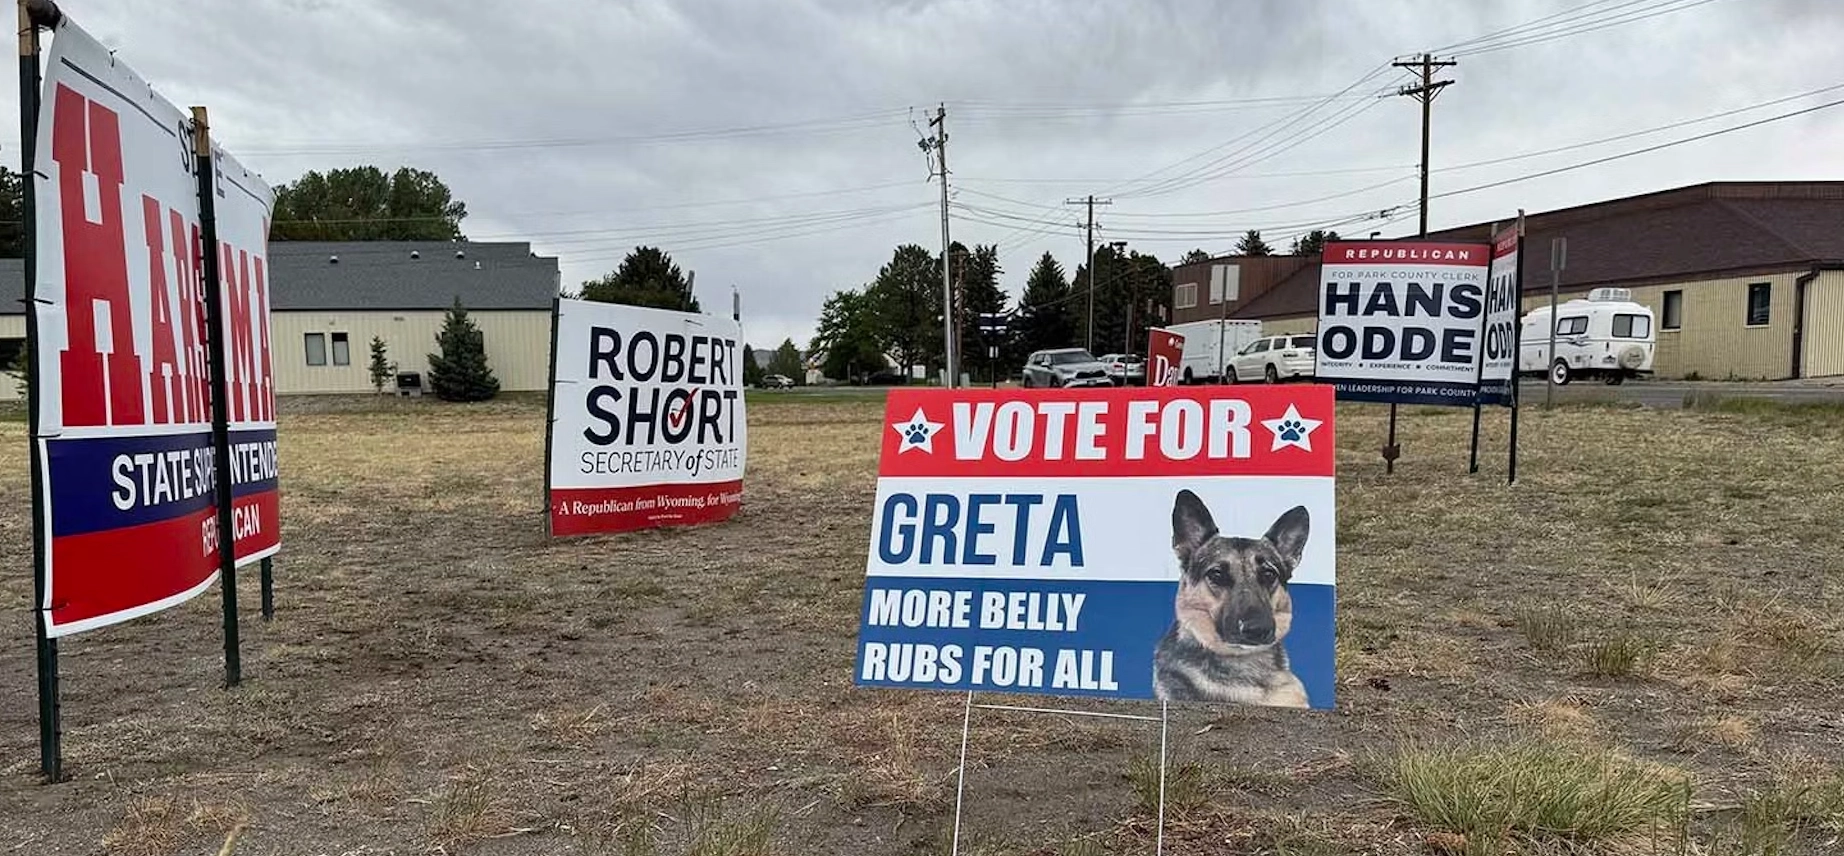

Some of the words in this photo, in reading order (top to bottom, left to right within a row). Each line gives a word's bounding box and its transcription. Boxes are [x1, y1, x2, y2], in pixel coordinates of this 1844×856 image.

[1345, 249, 1470, 260] REPUBLICAN
[1332, 271, 1353, 279] FOR
[1357, 271, 1386, 279] PARK
[1391, 271, 1437, 280] COUNTY
[1441, 272, 1479, 281] CLERK
[1488, 272, 1514, 314] HAN
[1325, 282, 1483, 319] HANS
[588, 326, 736, 386] ROBERT
[1322, 325, 1476, 364] ODDE
[1487, 321, 1512, 360] ODD
[1426, 364, 1475, 373] COMMITMENT
[1350, 384, 1395, 393] LEADERSHIP
[1397, 386, 1413, 394] FOR
[1415, 386, 1438, 395] PARK
[1440, 388, 1477, 398] COUNTY
[583, 385, 738, 446] SHORT
[952, 400, 1109, 461] VOTE
[1125, 398, 1252, 460] FOR
[112, 449, 194, 511] STATE
[580, 449, 685, 474] SECRETARY
[686, 450, 704, 476] of
[705, 448, 738, 471] STATE
[558, 501, 570, 516] A
[573, 500, 633, 517] Republican
[635, 497, 655, 512] from
[707, 493, 720, 506] for
[202, 504, 260, 557] REPUICAN
[878, 493, 1085, 568] GRETA
[868, 589, 972, 628] MORE
[979, 590, 1086, 632] BELLY
[861, 642, 964, 685] RUBS
[971, 646, 1044, 688] FOR
[1052, 648, 1119, 691] ALL
